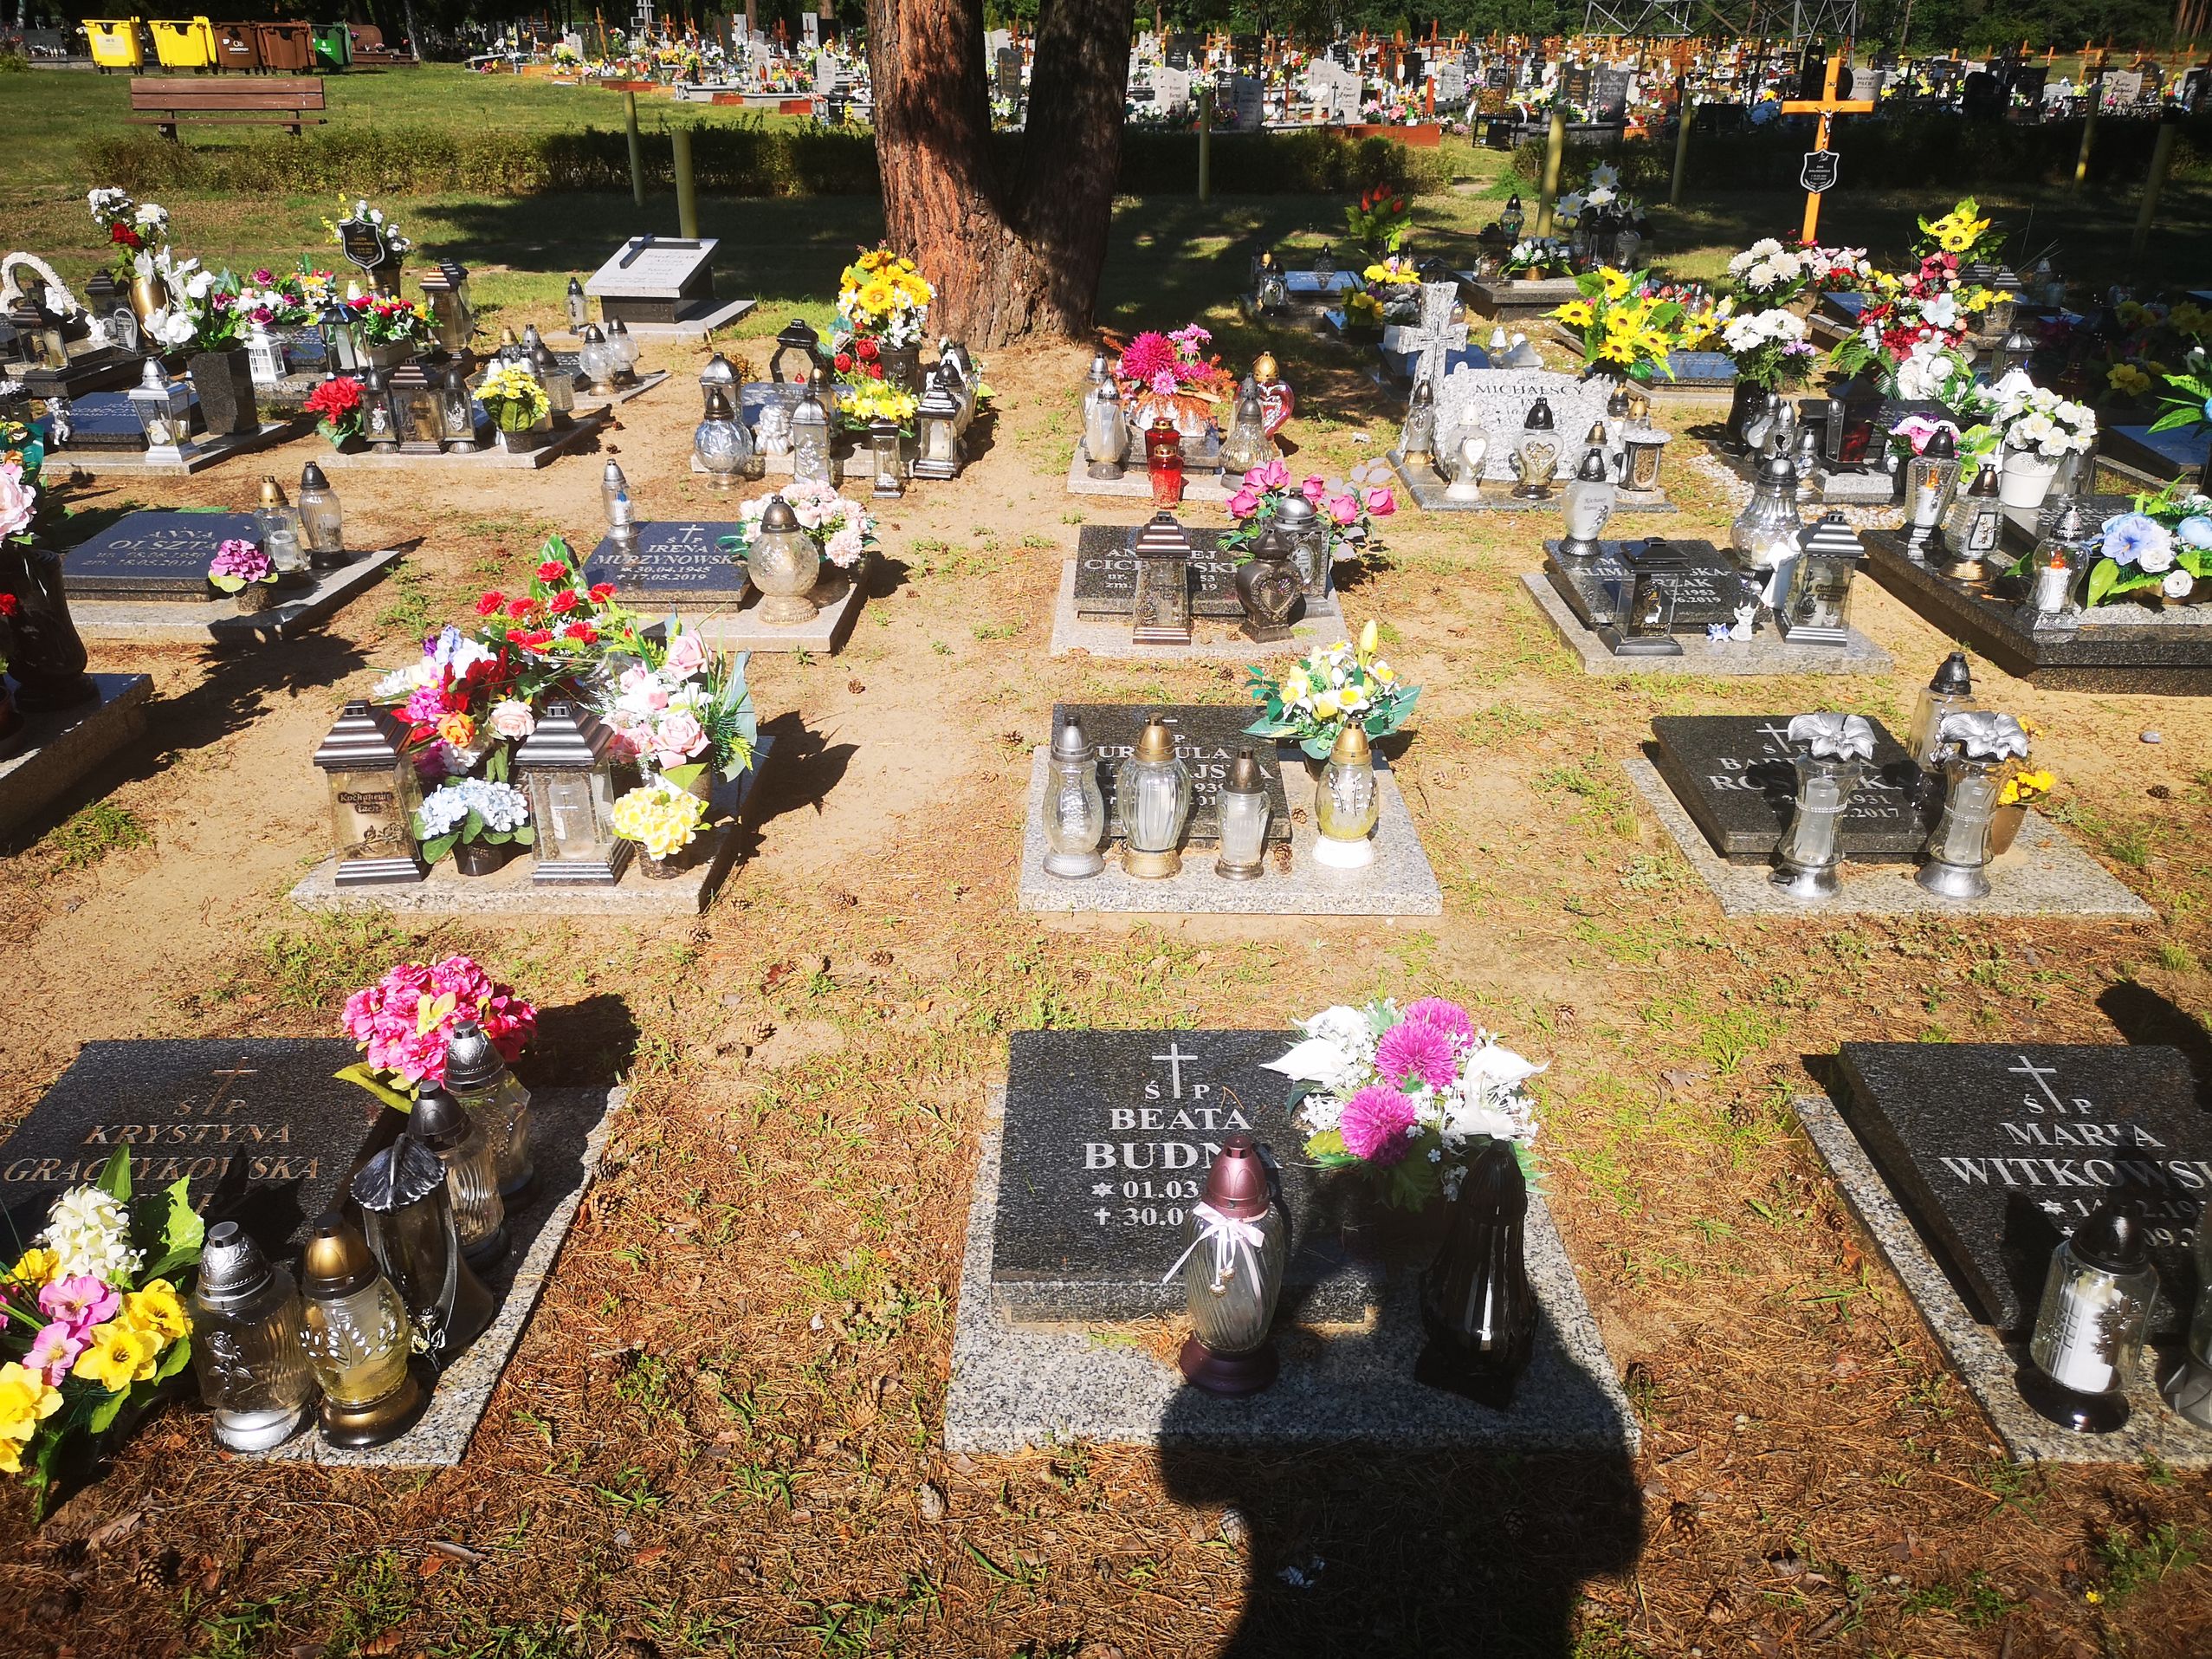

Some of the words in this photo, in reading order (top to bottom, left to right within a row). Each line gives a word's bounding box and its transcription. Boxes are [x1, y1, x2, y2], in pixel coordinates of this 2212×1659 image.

[142, 529, 216, 539] ANNA
[645, 544, 708, 553] IRENA
[592, 554, 736, 564] MURZYNOWSK
[1096, 746, 1232, 759] URULA
[1145, 1080, 1161, 1099] Ś
[1193, 1084, 1211, 1099] P
[2023, 1093, 2045, 1114] Ś
[2070, 1098, 2093, 1115] P
[1109, 1108, 1253, 1131] BEATA
[81, 1124, 290, 1144] KRYSTYNA
[1999, 1123, 2166, 1148] MARIA
[3, 1157, 320, 1183] GRACYKOSKA
